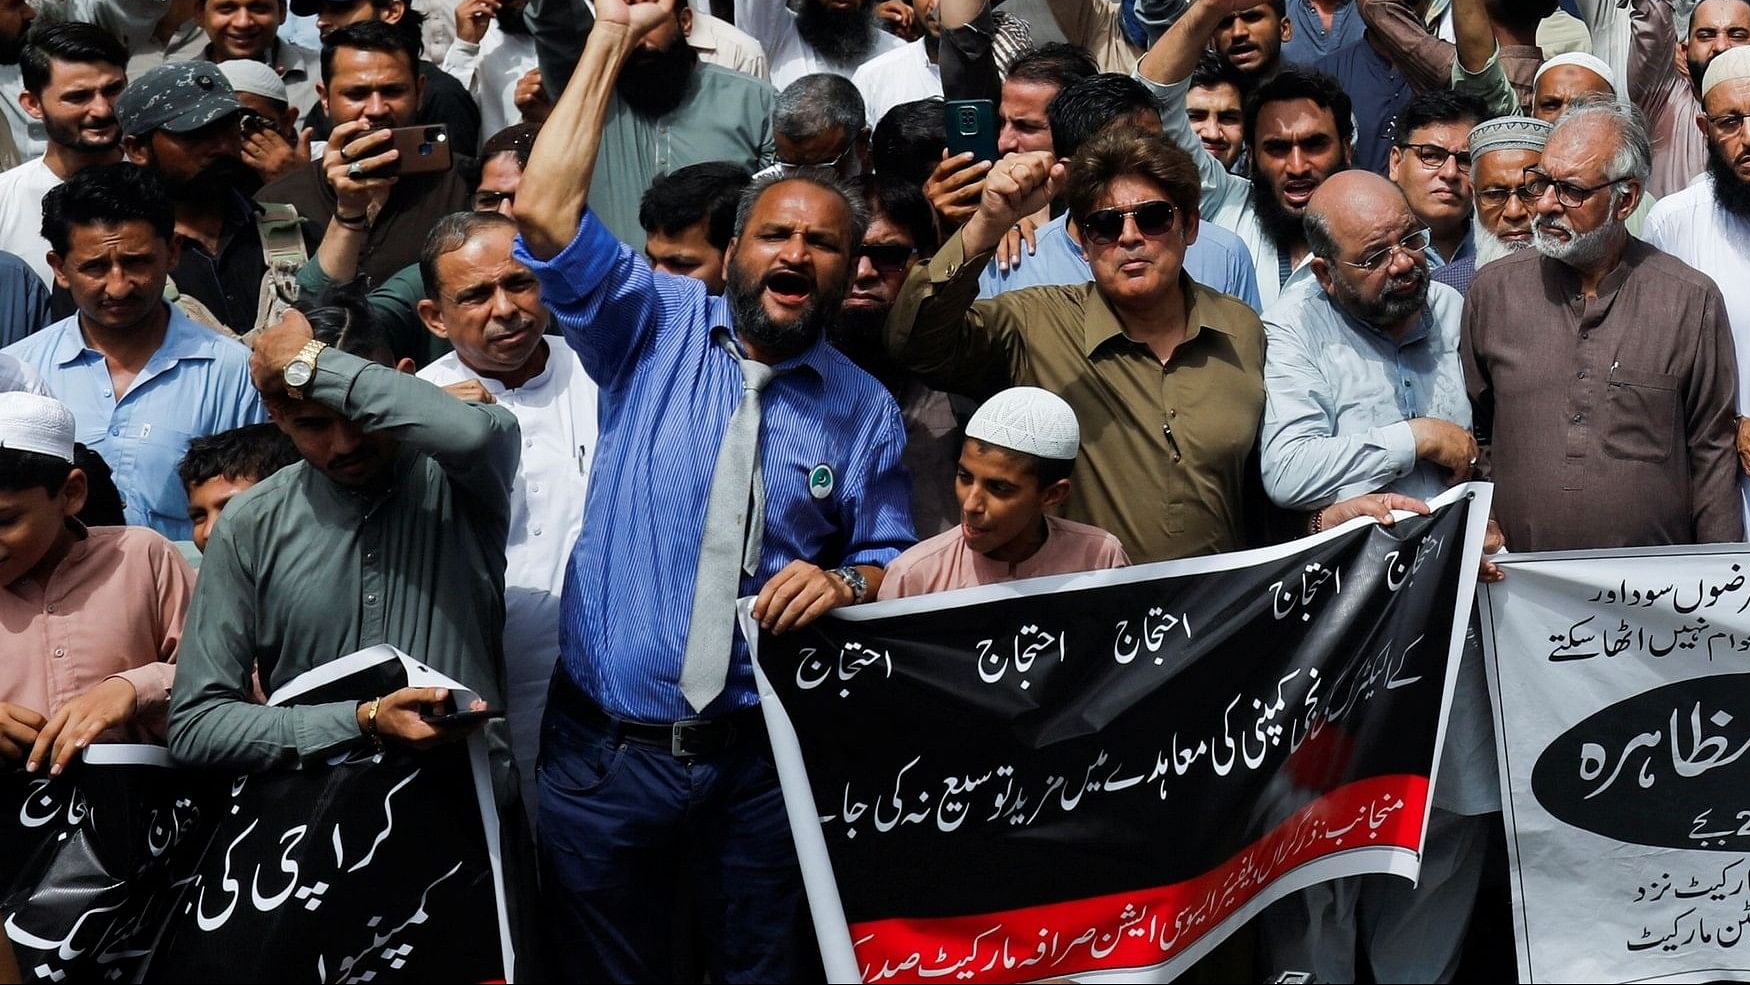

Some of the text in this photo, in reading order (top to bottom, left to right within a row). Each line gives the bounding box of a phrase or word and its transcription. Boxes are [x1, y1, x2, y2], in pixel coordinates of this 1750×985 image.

[1269, 562, 1341, 621] احتجاج
[976, 624, 1066, 689] احتجاج
[1114, 606, 1193, 665] احتجاج
[1548, 615, 1600, 663] سکتے
[1603, 619, 1644, 657] اٹھا
[1649, 618, 1708, 657] نہیں
[796, 642, 892, 697] احتجاج
[1211, 693, 1242, 776] کی
[1242, 668, 1301, 769] کمپنی
[874, 756, 921, 832] کی
[1060, 749, 1109, 811] میں
[1104, 732, 1208, 800] معاہدے
[901, 791, 931, 826] نہ
[1689, 808, 1735, 847] بجے
[197, 768, 421, 931] کراچی کی
[1633, 873, 1672, 903] نزد
[918, 924, 1016, 980] مارکیٹ
[1627, 907, 1712, 952] مارکیٹ
[866, 951, 921, 983] صدر
